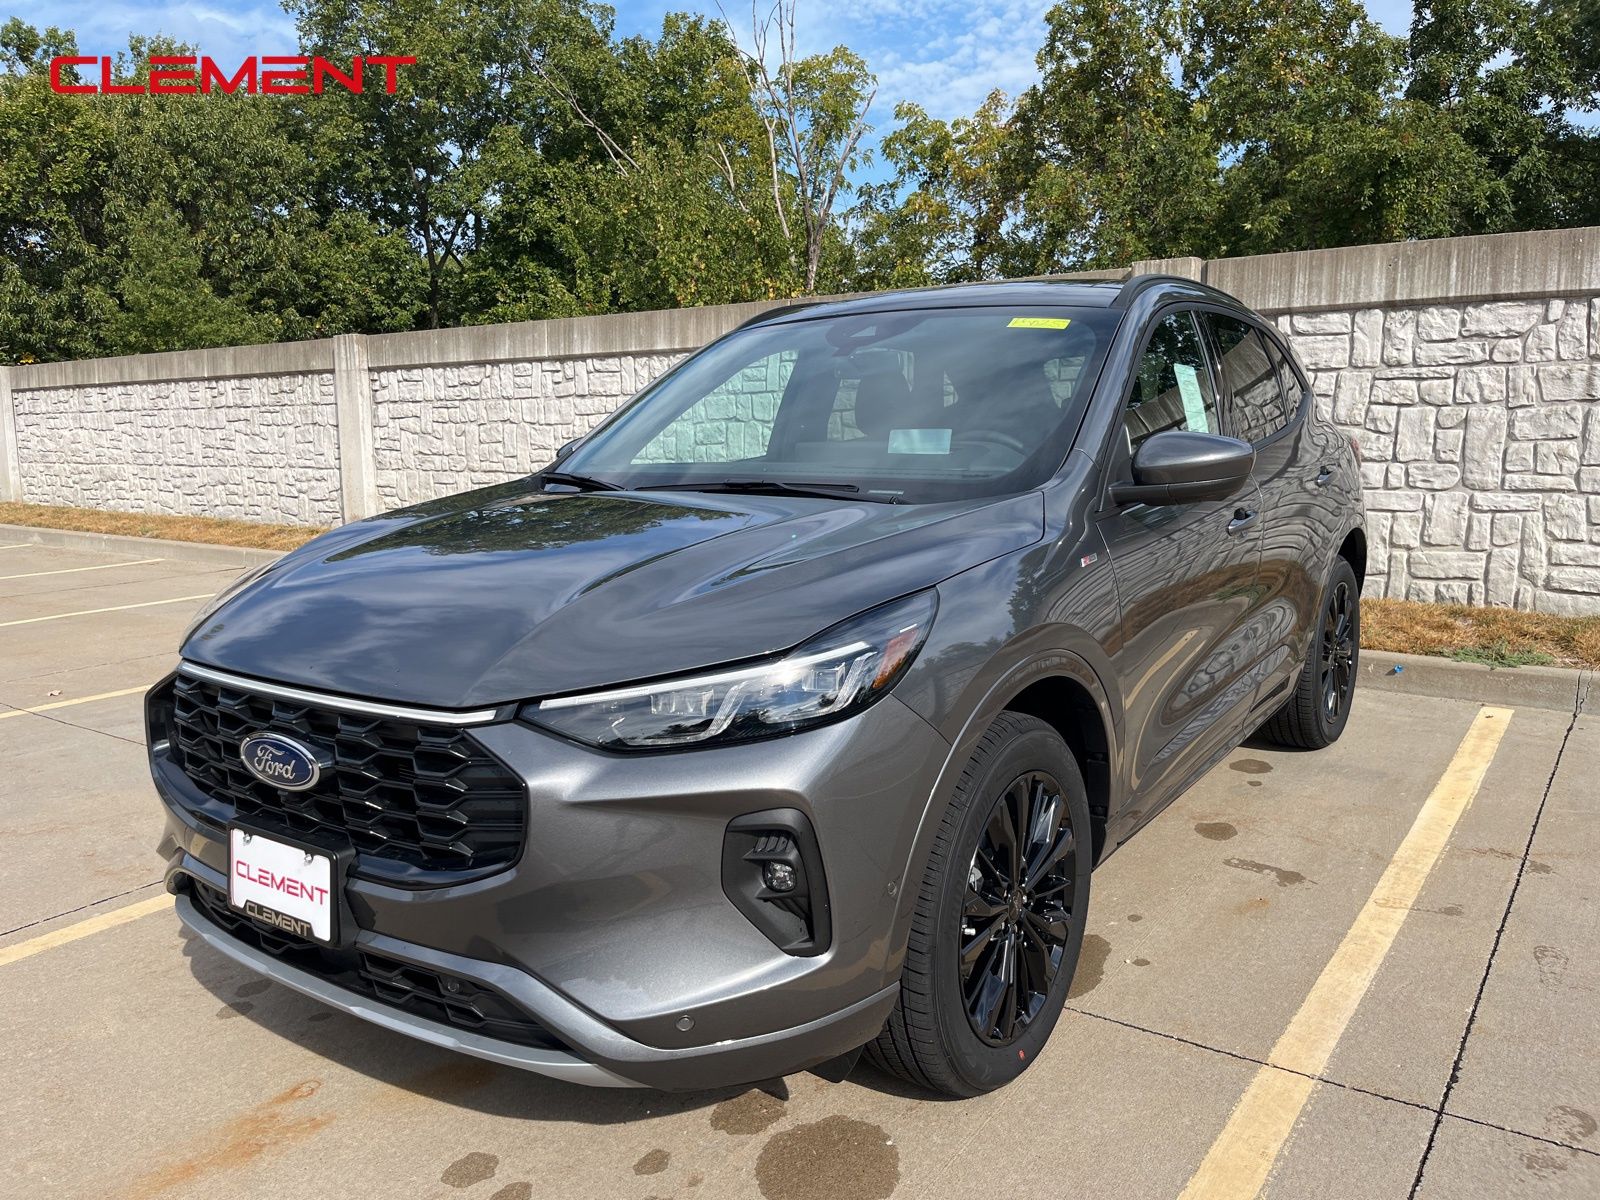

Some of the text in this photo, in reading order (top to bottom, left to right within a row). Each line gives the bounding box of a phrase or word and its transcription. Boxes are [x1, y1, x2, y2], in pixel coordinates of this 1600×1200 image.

[254, 744, 296, 780] Ford
[236, 860, 328, 905] CLEMENT
[246, 901, 310, 937] CLEMENT
